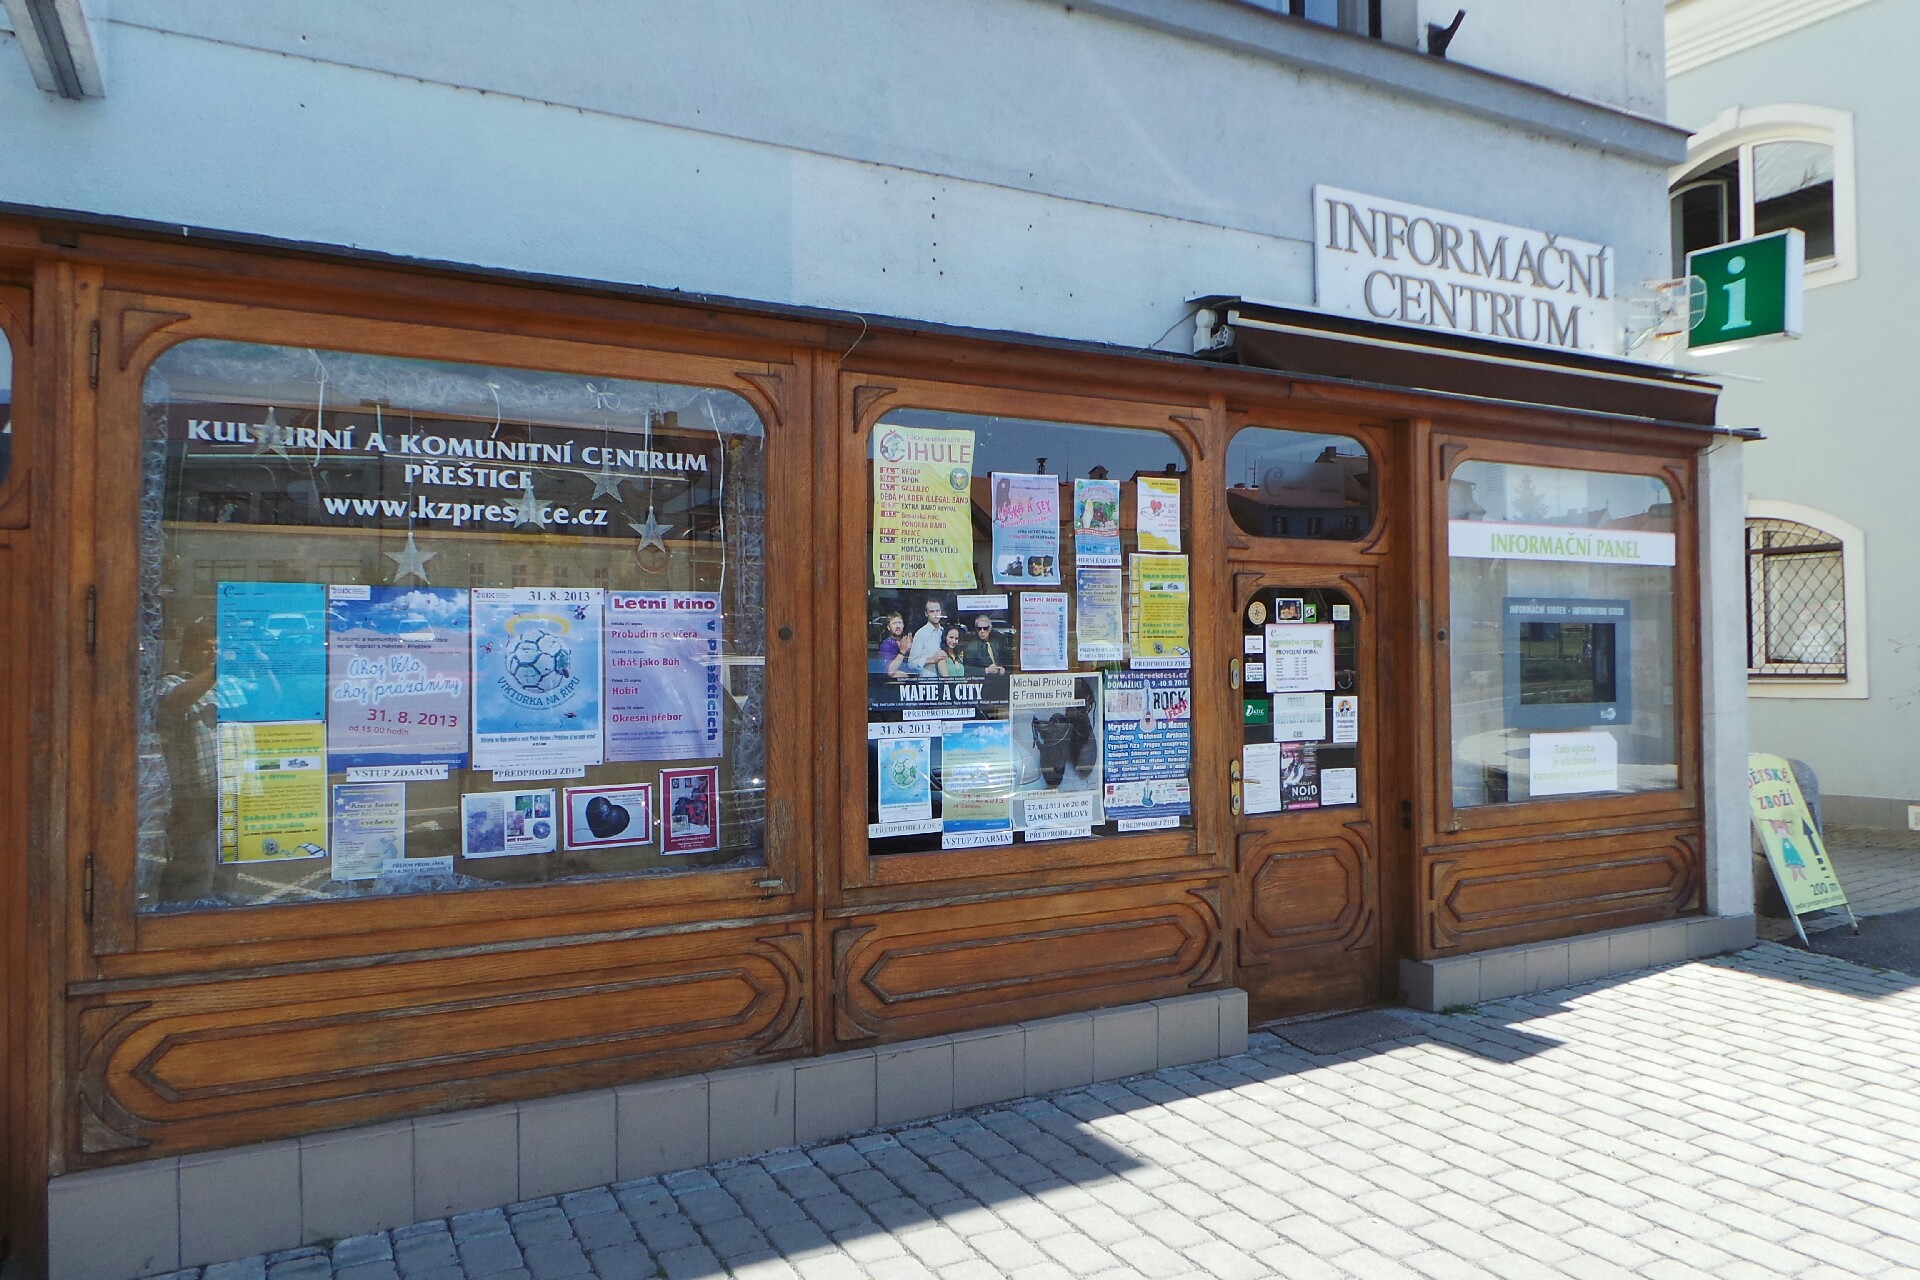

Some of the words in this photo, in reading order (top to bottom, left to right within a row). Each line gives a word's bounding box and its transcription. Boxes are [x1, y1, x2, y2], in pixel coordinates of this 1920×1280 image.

[1324, 199, 1612, 300] INFORMAČNÍ
[1363, 270, 1582, 350] CENTRUM
[364, 432, 388, 452] A
[400, 434, 574, 463] KOMUNITNÍ
[581, 446, 708, 472] CENTRUM
[404, 459, 534, 489] PŘEŠTICE
[1490, 532, 1593, 557] INFORMAČNÍ
[1596, 539, 1641, 559] PANEL
[528, 590, 546, 601] 31.
[549, 590, 560, 601] 8.
[564, 591, 591, 602] 2013
[613, 597, 667, 610] Letní
[673, 598, 716, 610] kino
[660, 630, 671, 638] se
[672, 629, 698, 639] včera
[638, 657, 660, 668] jako
[349, 658, 385, 681] Ahoj
[1107, 672, 1188, 680] www.chodrockfest.cz
[334, 681, 368, 704] ahoj
[374, 674, 460, 702] prázdniny
[1012, 677, 1041, 688] Michal
[1042, 677, 1073, 689] Prokop
[1107, 680, 1143, 689] DOMAŽLICE
[497, 675, 544, 706] VIKTORKA
[545, 694, 561, 705] NA
[560, 675, 581, 698] ŘÍPU
[612, 686, 639, 696] Hobit
[899, 684, 939, 702] MAFIE
[942, 684, 952, 701] A
[954, 683, 984, 701] CITY
[1012, 691, 1020, 701] &
[1021, 690, 1054, 700] Framus
[1055, 689, 1073, 699] Five
[1152, 690, 1187, 711] ROCK
[367, 708, 392, 723] 31.
[397, 711, 412, 724] 8.
[417, 712, 458, 728] 2013
[651, 712, 683, 724] přebor
[907, 709, 955, 718] PŘEDPRODEJ
[386, 727, 411, 736] hodin
[880, 725, 894, 736] 31.
[897, 725, 906, 735] 8.
[909, 724, 932, 734] 2013
[354, 769, 391, 778] VSTUP
[392, 768, 441, 778] ZDARMA
[498, 768, 558, 777] PŘEDPRODEJ
[1291, 784, 1318, 798] NOID
[1755, 788, 1795, 810] ZBOŽÍ
[1028, 811, 1053, 822] ZÁMEK
[1054, 809, 1089, 821] NEBÍLOVY
[1122, 819, 1163, 829] PŘEDPRODEJ
[1163, 818, 1177, 827] ZDE
[875, 825, 921, 835] PŘEDPRODEJ
[1029, 829, 1074, 840] PŘEDPRODEJ
[1074, 828, 1087, 837] ZDE
[945, 836, 972, 846] VSTUP
[973, 834, 1010, 846] ZDARMA
[1809, 882, 1829, 896] 200
